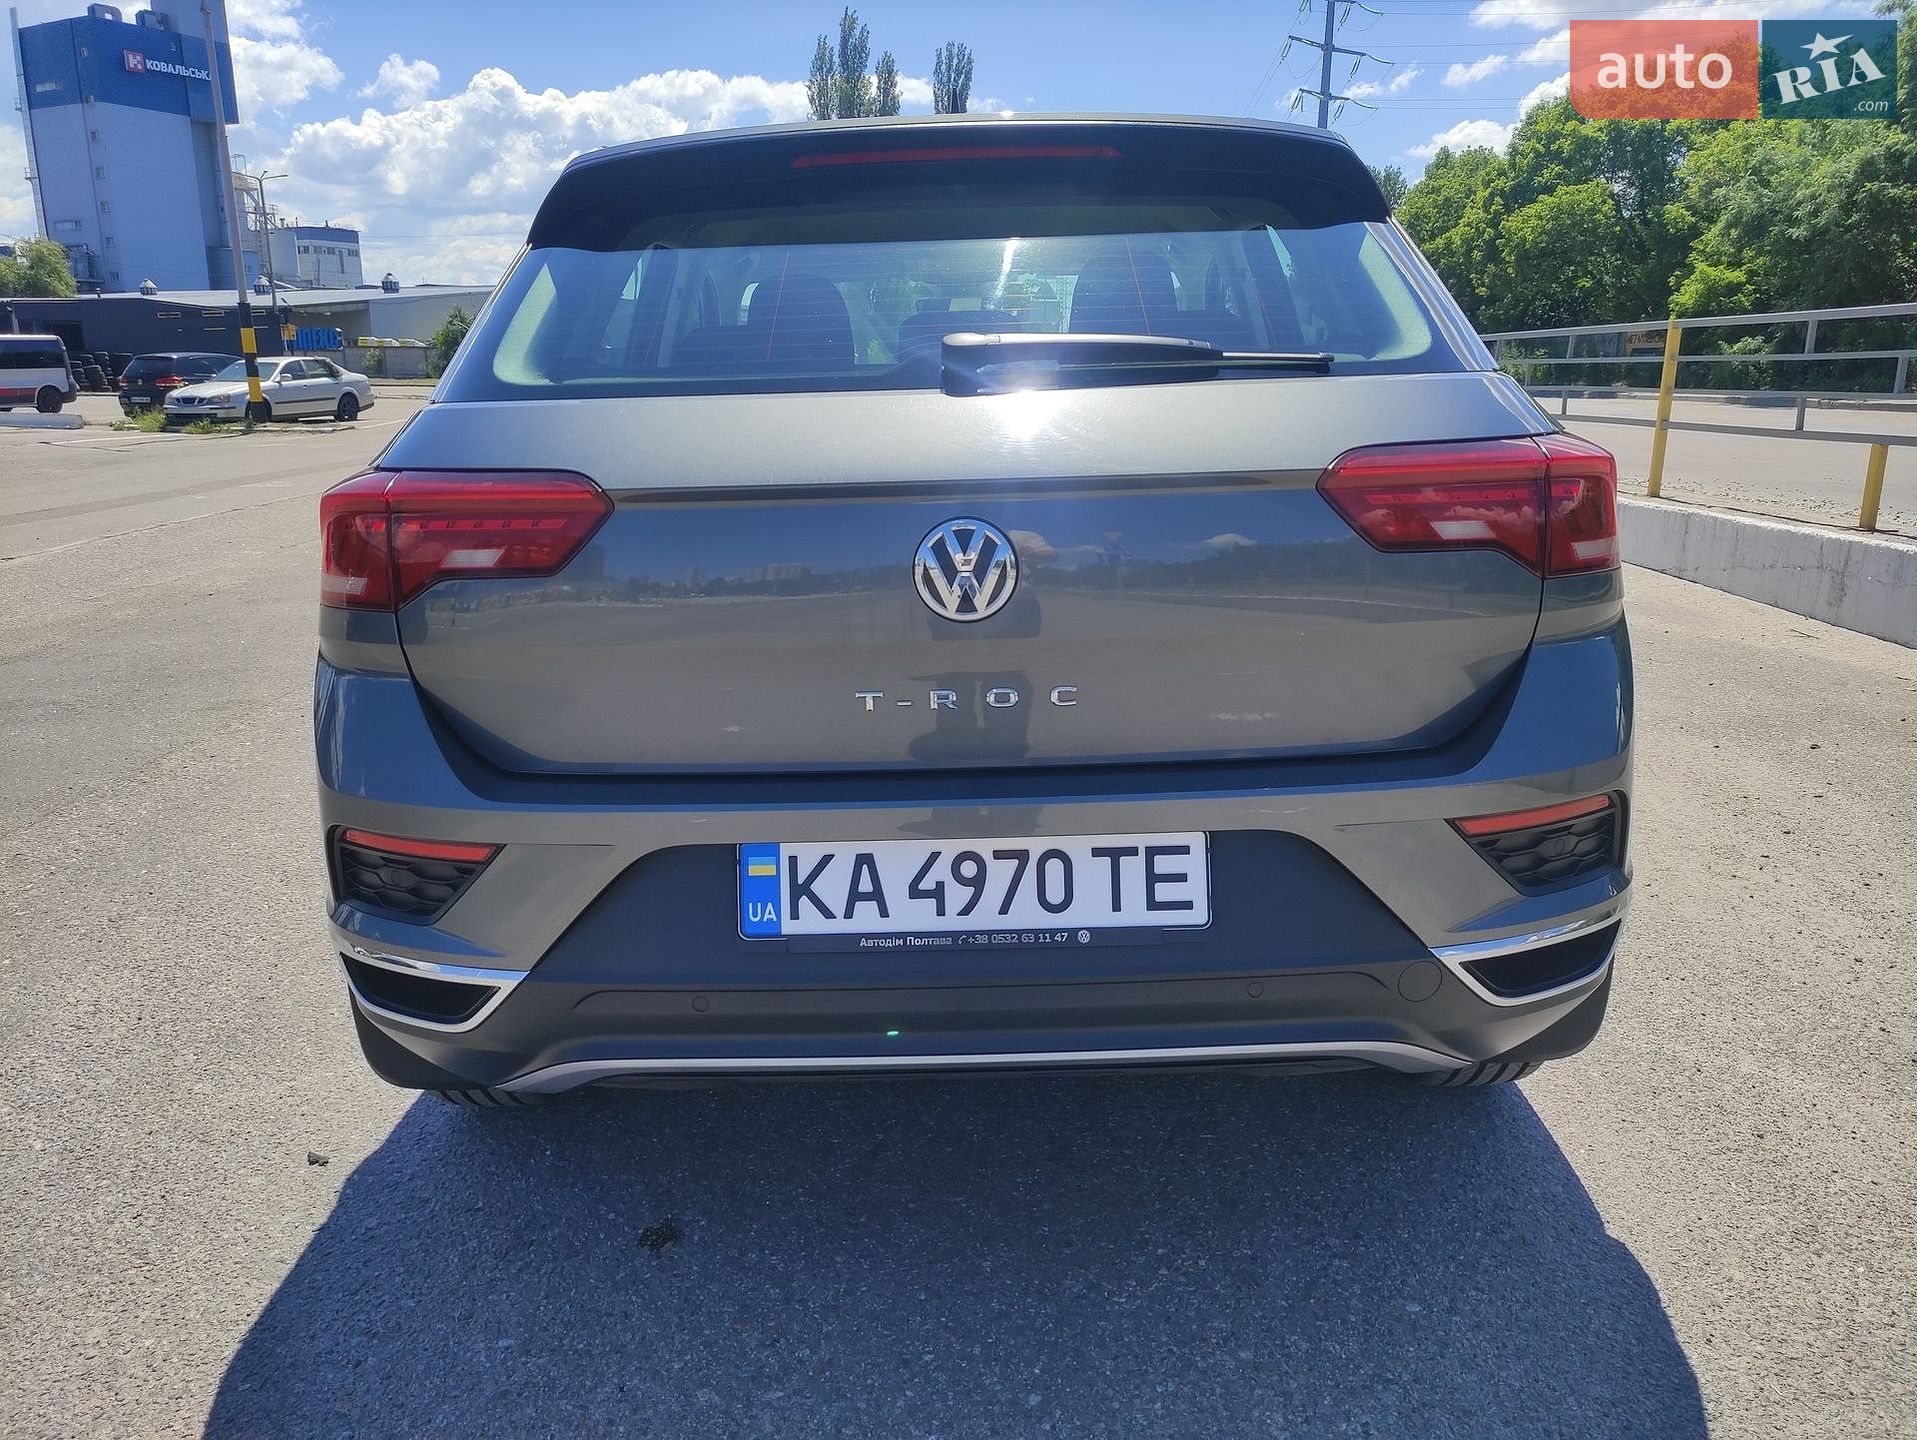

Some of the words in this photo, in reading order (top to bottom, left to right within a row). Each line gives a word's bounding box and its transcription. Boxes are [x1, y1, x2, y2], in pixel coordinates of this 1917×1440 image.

[145, 58, 211, 80] КОВАЛЬСЬК
[788, 853, 890, 921] KA
[908, 848, 1074, 917] 4970
[1091, 845, 1194, 912] TE
[748, 902, 778, 922] UA
[860, 936, 904, 947] Автодім
[906, 936, 952, 946] Полтава
[1021, 933, 1035, 943] 63
[1038, 933, 1051, 943] 11
[1054, 932, 1068, 942] 47
